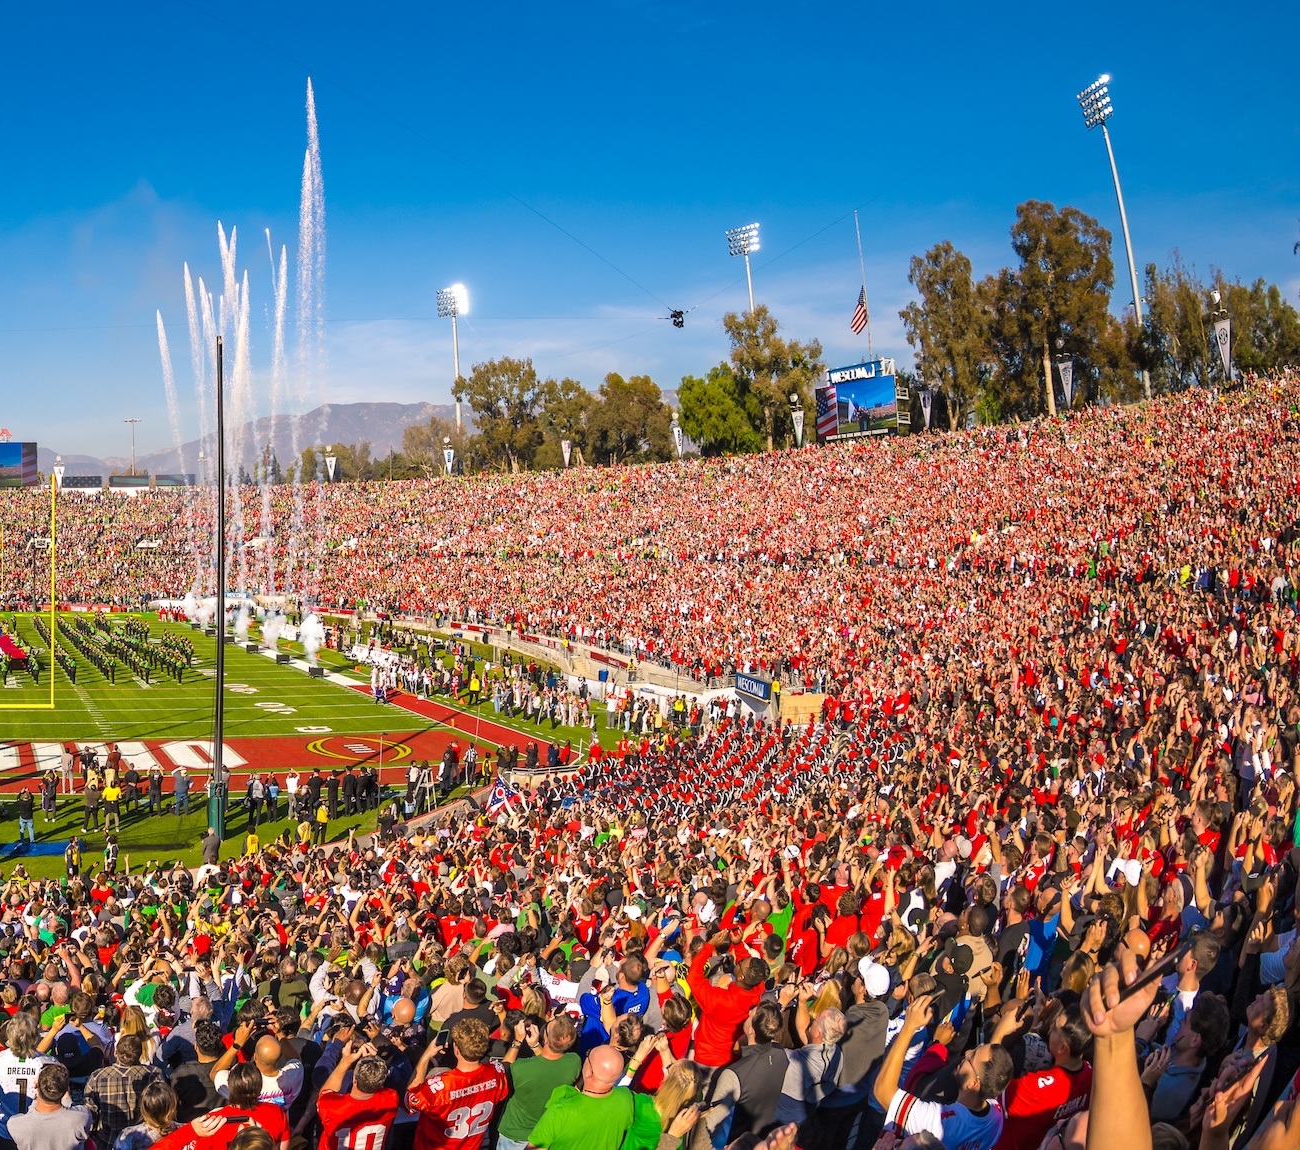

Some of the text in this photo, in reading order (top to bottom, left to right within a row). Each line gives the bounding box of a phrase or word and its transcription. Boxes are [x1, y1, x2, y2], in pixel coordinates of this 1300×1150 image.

[830, 367, 867, 384] WESCOM
[738, 676, 759, 694] WESCOM
[7, 1067, 37, 1075] OREGON
[450, 1078, 497, 1100] BUCKEYES
[444, 1101, 494, 1139] 32
